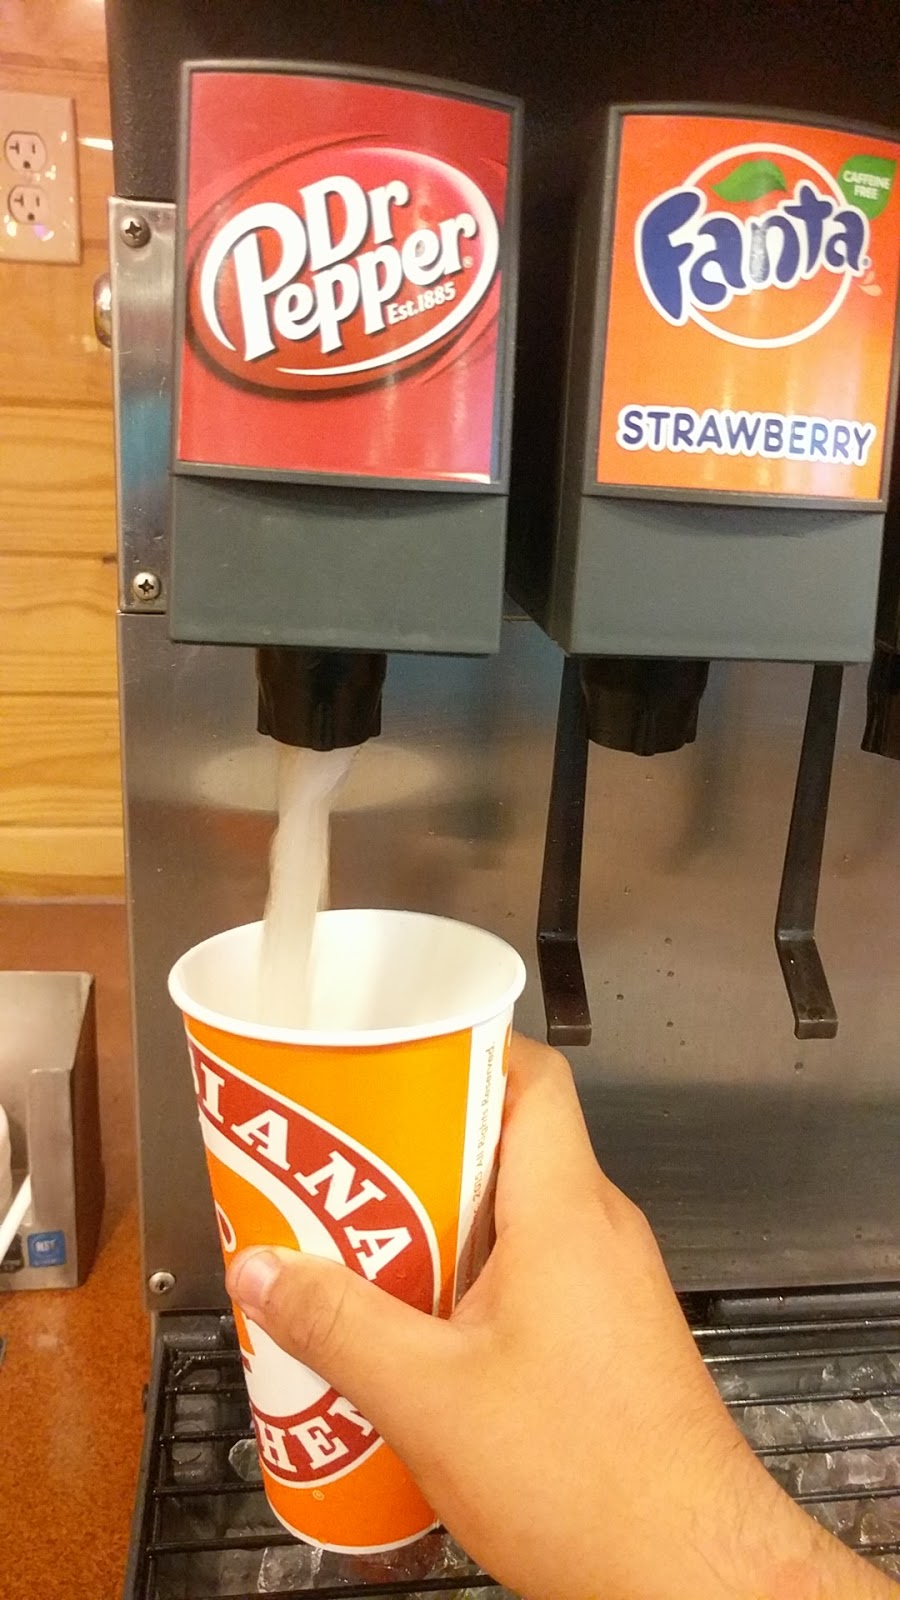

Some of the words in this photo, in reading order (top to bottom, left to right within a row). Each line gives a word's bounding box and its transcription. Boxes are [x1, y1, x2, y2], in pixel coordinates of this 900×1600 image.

[842, 170, 891, 190] CAFFEINE
[854, 184, 879, 200] FREE
[298, 175, 410, 271] Dr
[637, 182, 865, 322] Fanta
[200, 202, 477, 361] Pepper
[619, 408, 874, 462] STRAWBERRY
[477, 1108, 488, 1147] Rights
[189, 1047, 413, 1281] IANA
[475, 1151, 484, 1167] All
[473, 1171, 483, 1202] 2015
